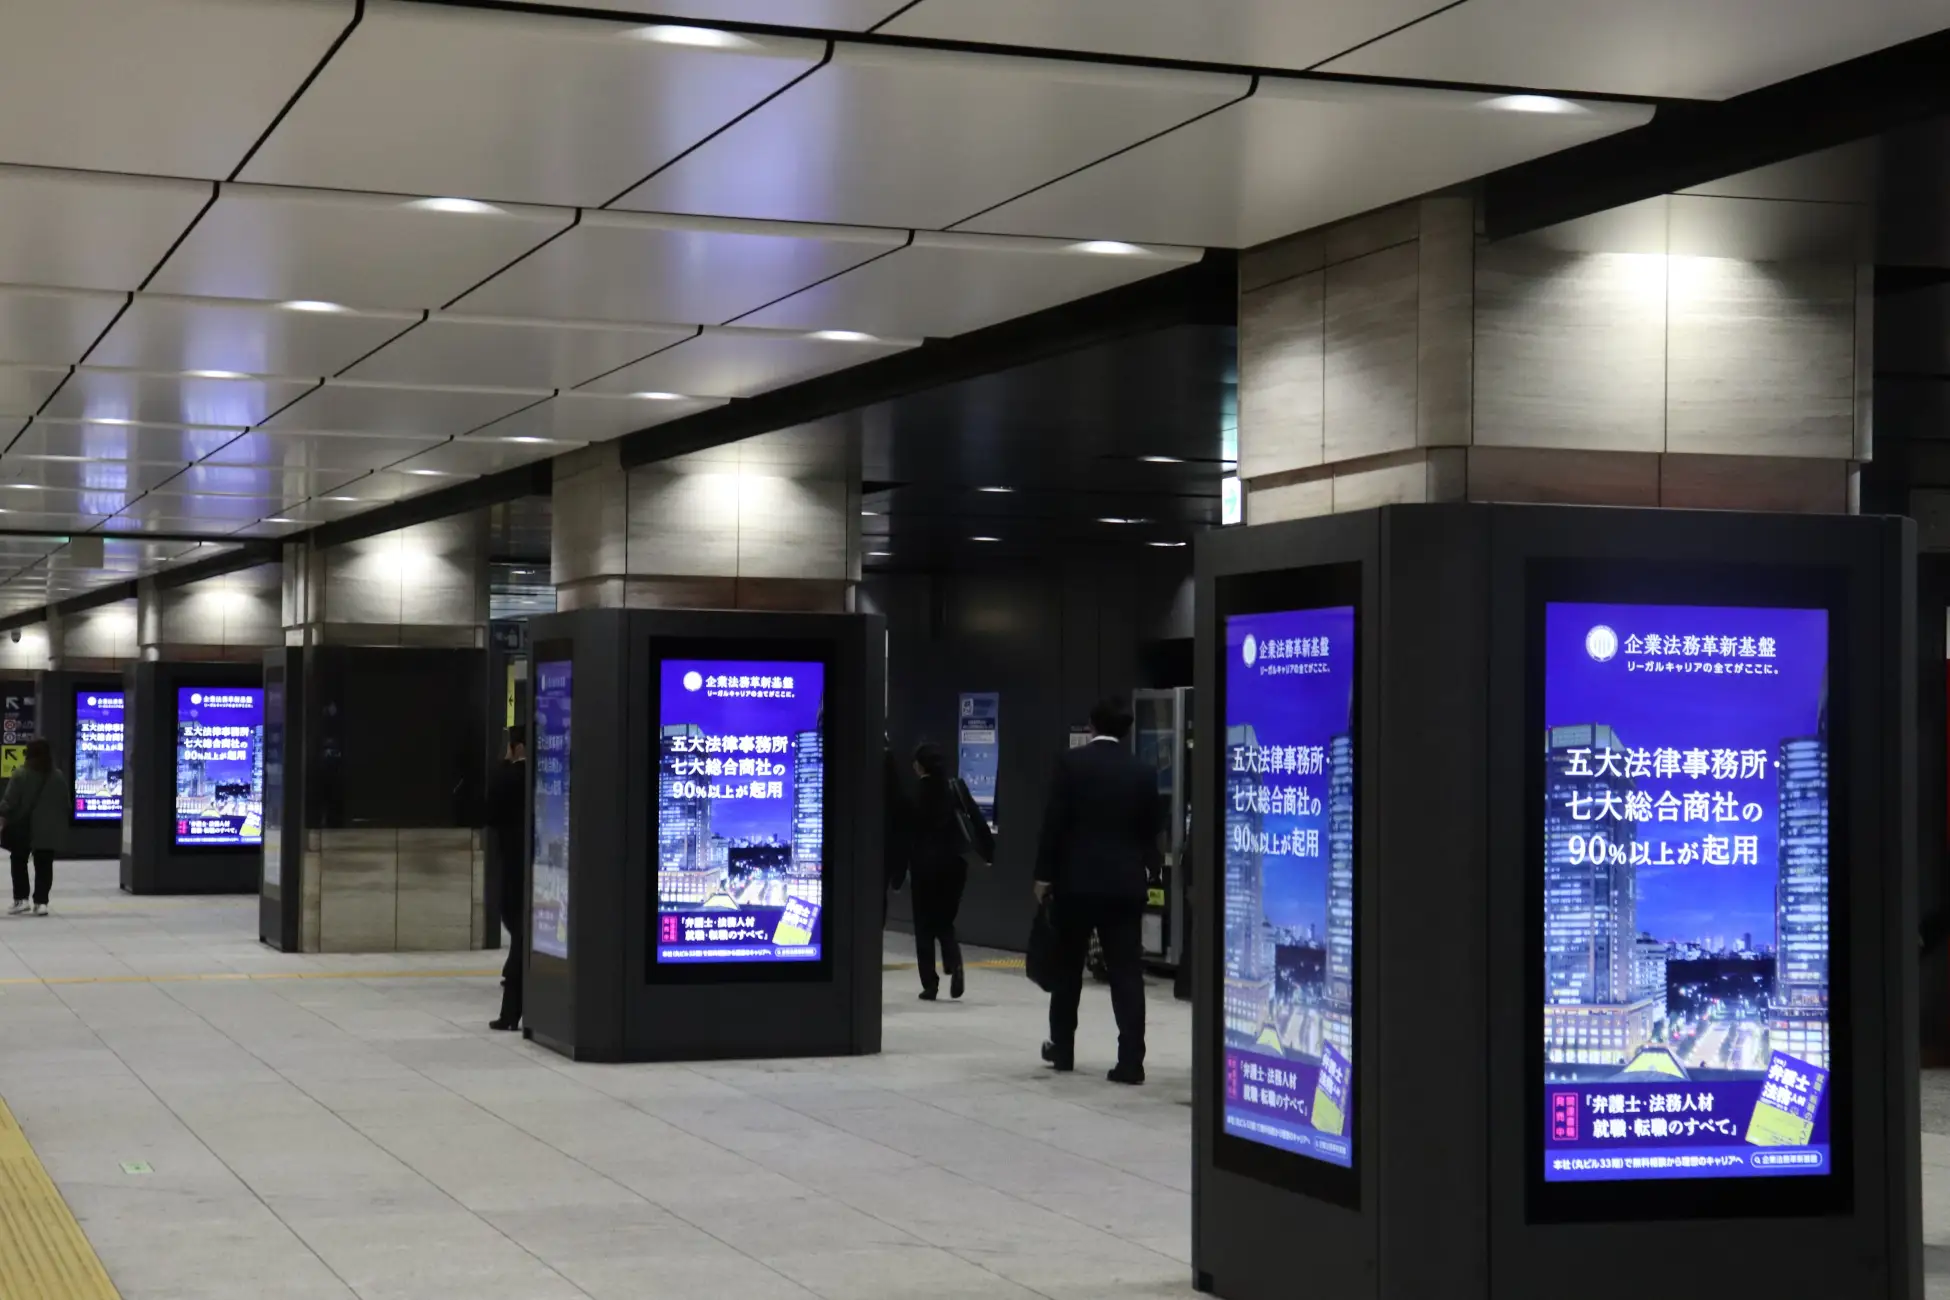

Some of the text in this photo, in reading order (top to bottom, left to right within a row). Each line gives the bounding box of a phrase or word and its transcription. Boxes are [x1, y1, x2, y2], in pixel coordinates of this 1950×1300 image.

[1259, 637, 1330, 660] 企業法務革新基盤
[1624, 634, 1776, 658] 企業法務革新基盤
[1627, 661, 1779, 675] リーガルキャリアの全てがここに。
[705, 675, 794, 689] 企業法務革新基盤
[671, 735, 796, 754] 五大法律事務所・
[671, 758, 786, 776] 七大総合商社の
[1564, 747, 1780, 780] 五大法律事務所・
[672, 781, 783, 799] 90%以上が起用
[1232, 785, 1321, 817] 七大総合商社の
[1564, 790, 1763, 823] 七大総合商社の
[1568, 834, 1759, 866] 90%以上が起用
